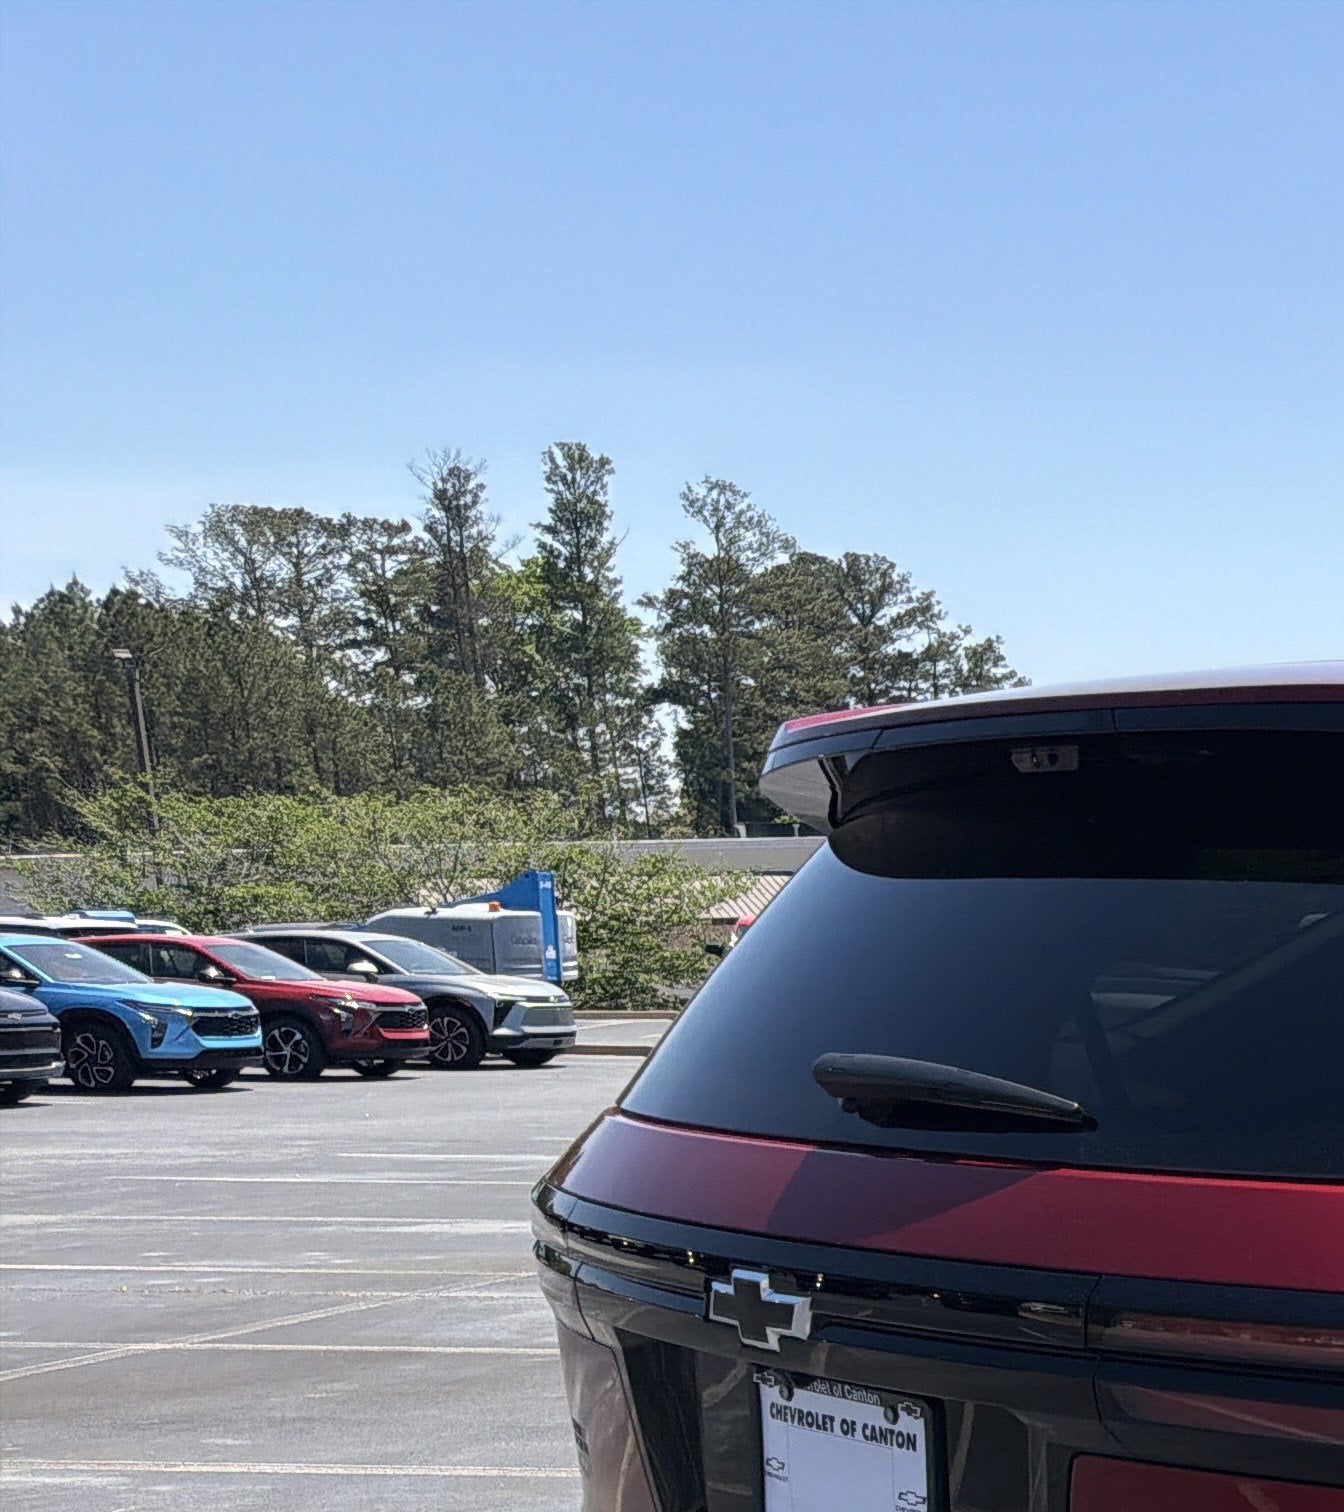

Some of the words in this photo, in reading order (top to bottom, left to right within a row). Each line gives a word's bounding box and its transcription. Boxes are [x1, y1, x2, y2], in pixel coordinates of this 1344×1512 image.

[844, 1384, 881, 1405] Canton
[769, 1401, 835, 1433] CHEVROLET
[840, 1418, 857, 1438] OF
[862, 1422, 917, 1452] CANTON
